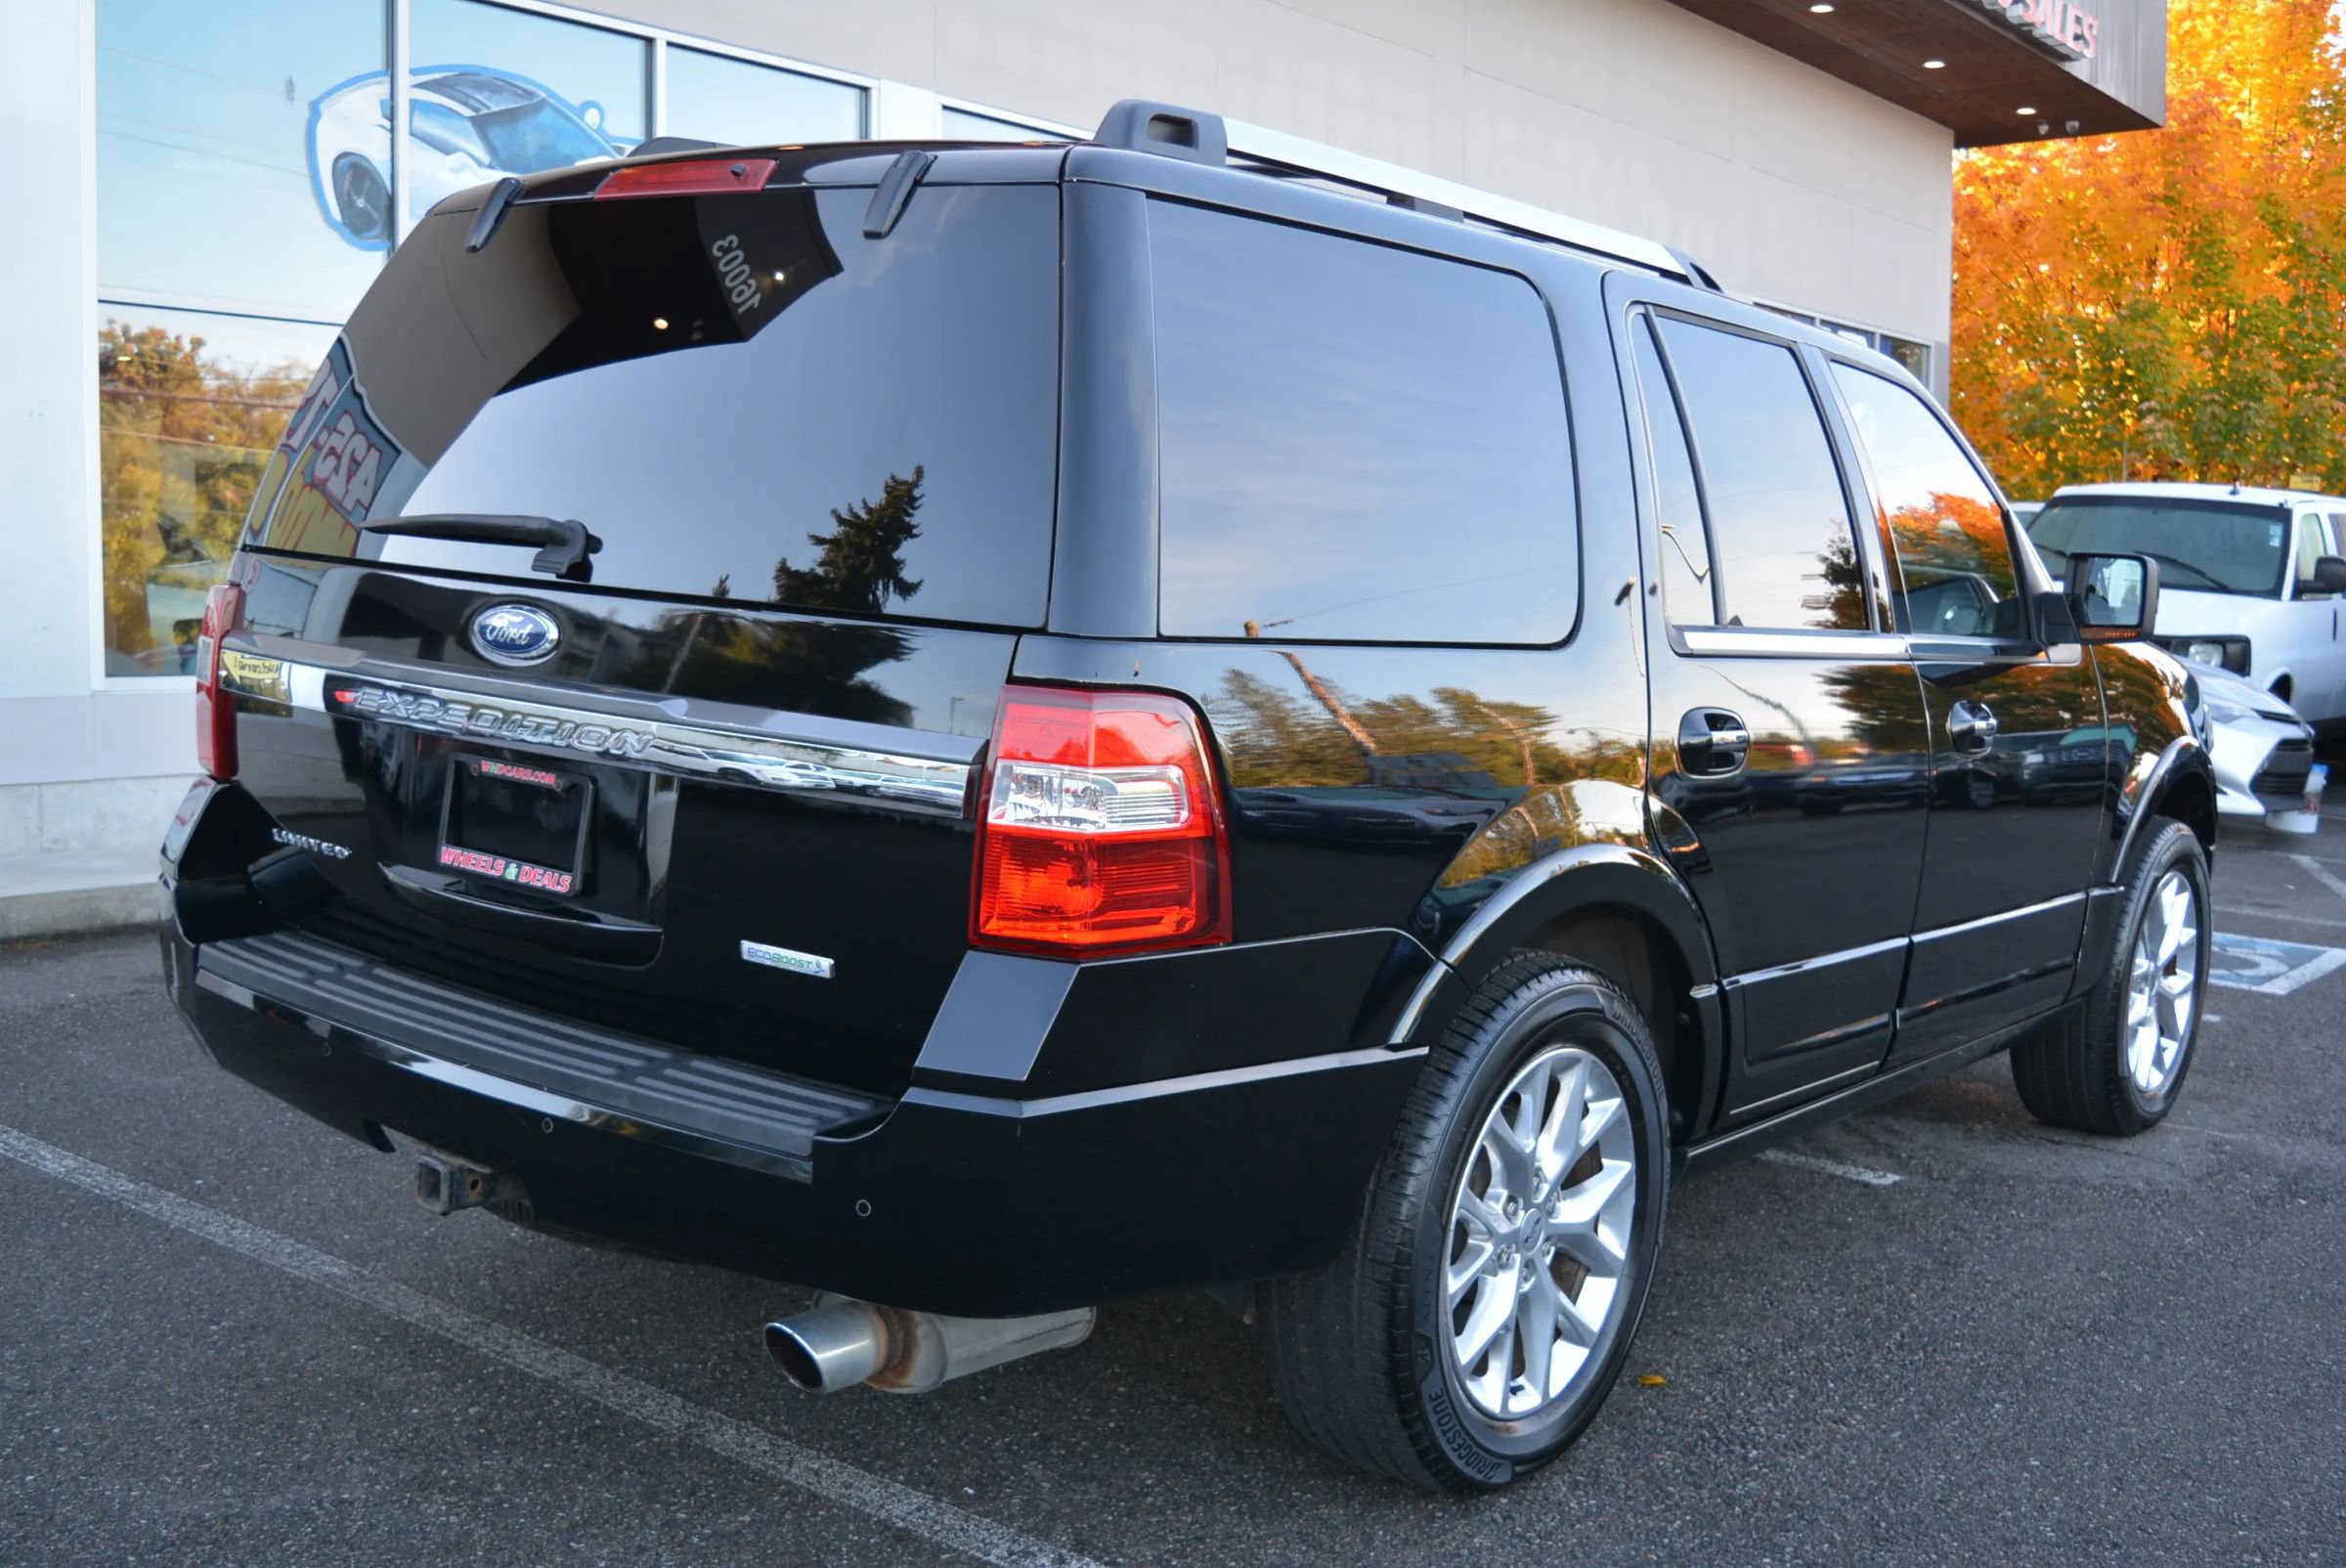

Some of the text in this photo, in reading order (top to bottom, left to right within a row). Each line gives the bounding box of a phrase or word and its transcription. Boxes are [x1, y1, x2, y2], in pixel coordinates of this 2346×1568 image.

[486, 611, 534, 645] Ford
[355, 686, 657, 757] EXPEDITION
[272, 827, 352, 859] LIMITED
[440, 846, 573, 893] WHEELS & DEALS
[747, 946, 813, 969] ECOBOOST
[1429, 1387, 1504, 1481] BRIDGESTONE
